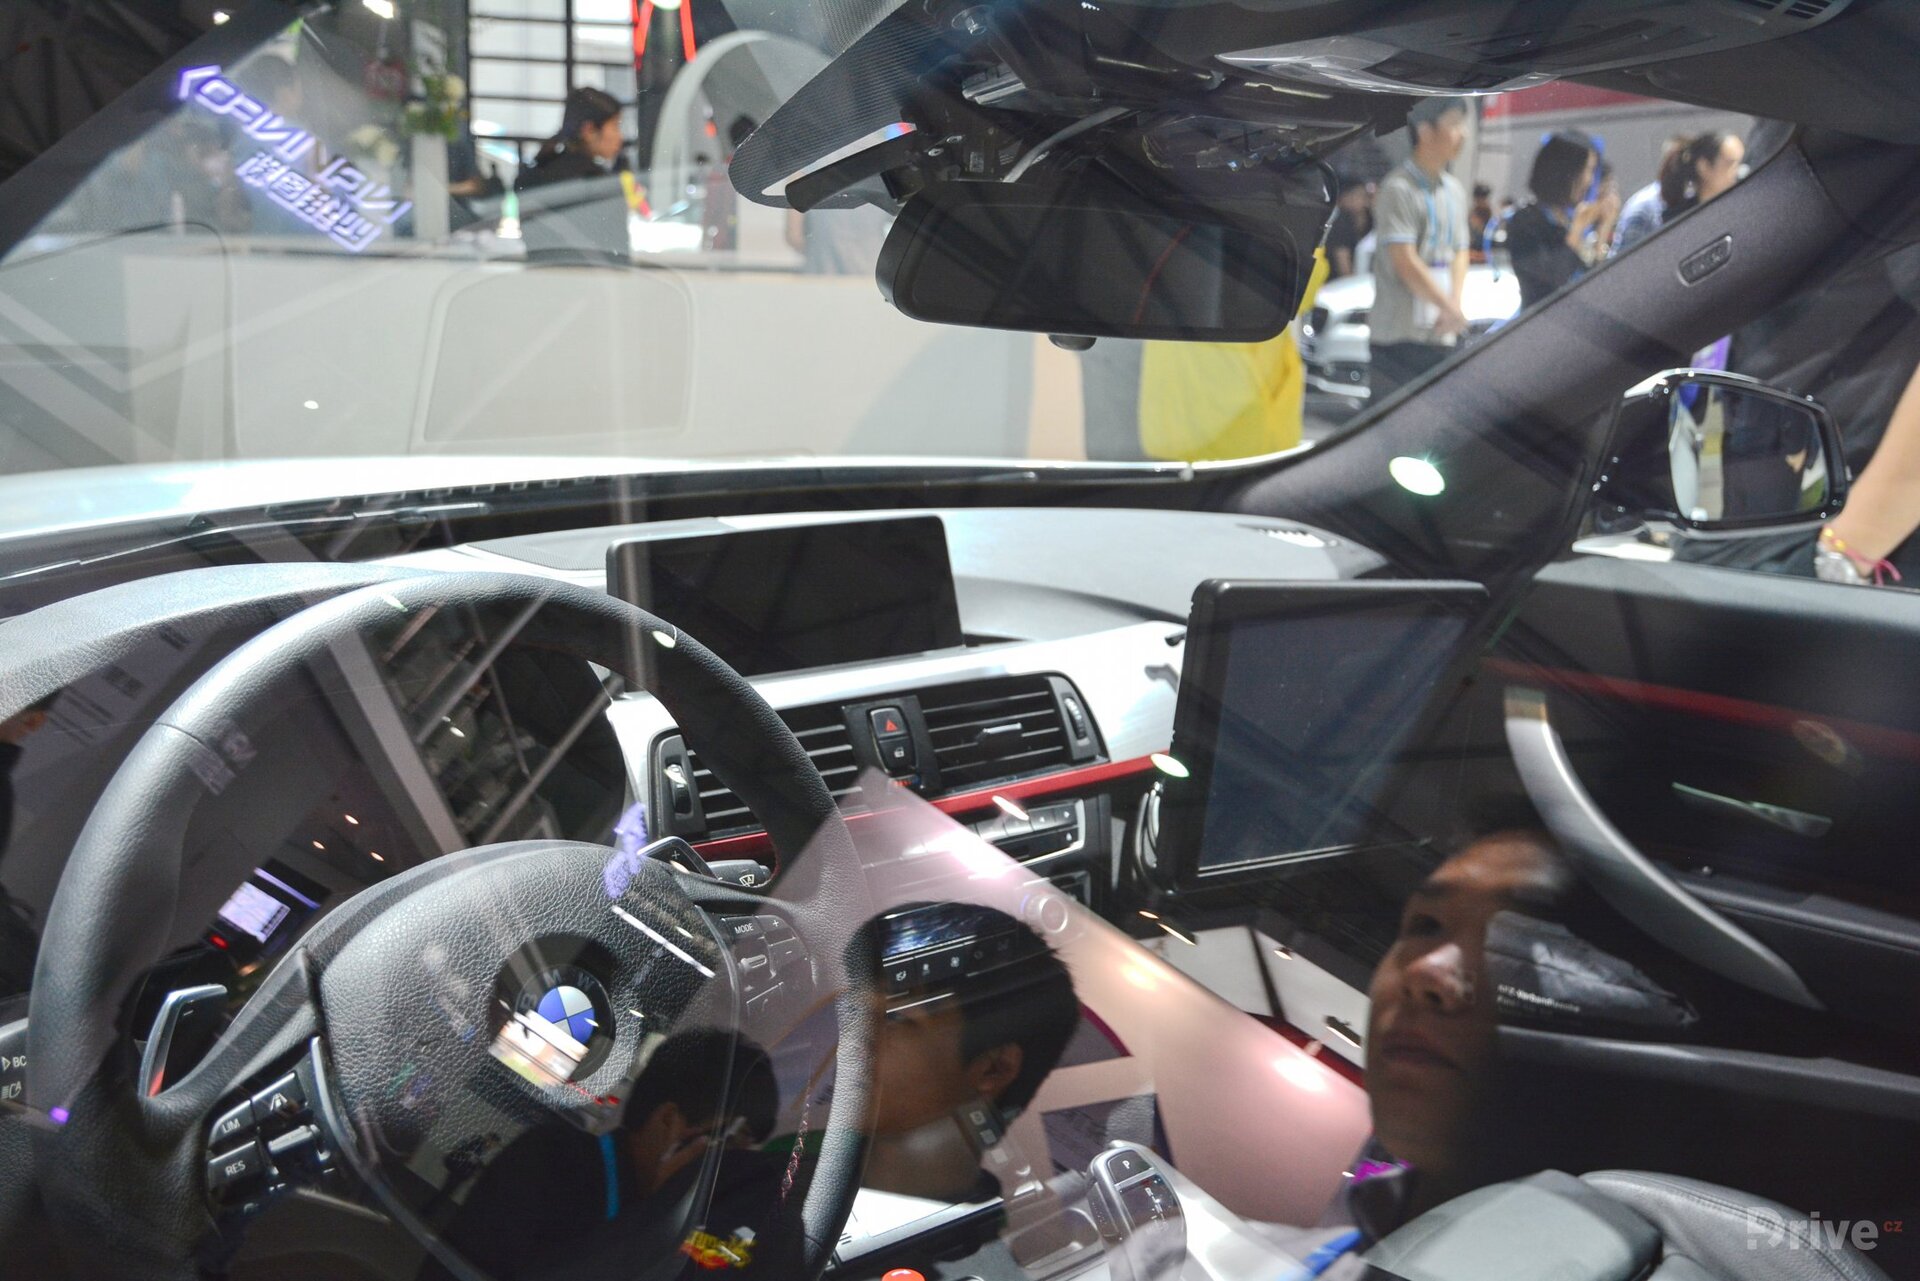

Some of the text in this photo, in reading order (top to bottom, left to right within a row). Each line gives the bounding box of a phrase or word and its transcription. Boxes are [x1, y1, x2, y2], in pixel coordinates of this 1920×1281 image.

[734, 922, 754, 934] MODE
[12, 1055, 27, 1068] BC
[221, 1117, 241, 1134] LIM
[225, 1160, 246, 1176] RES
[1122, 1160, 1130, 1170] P
